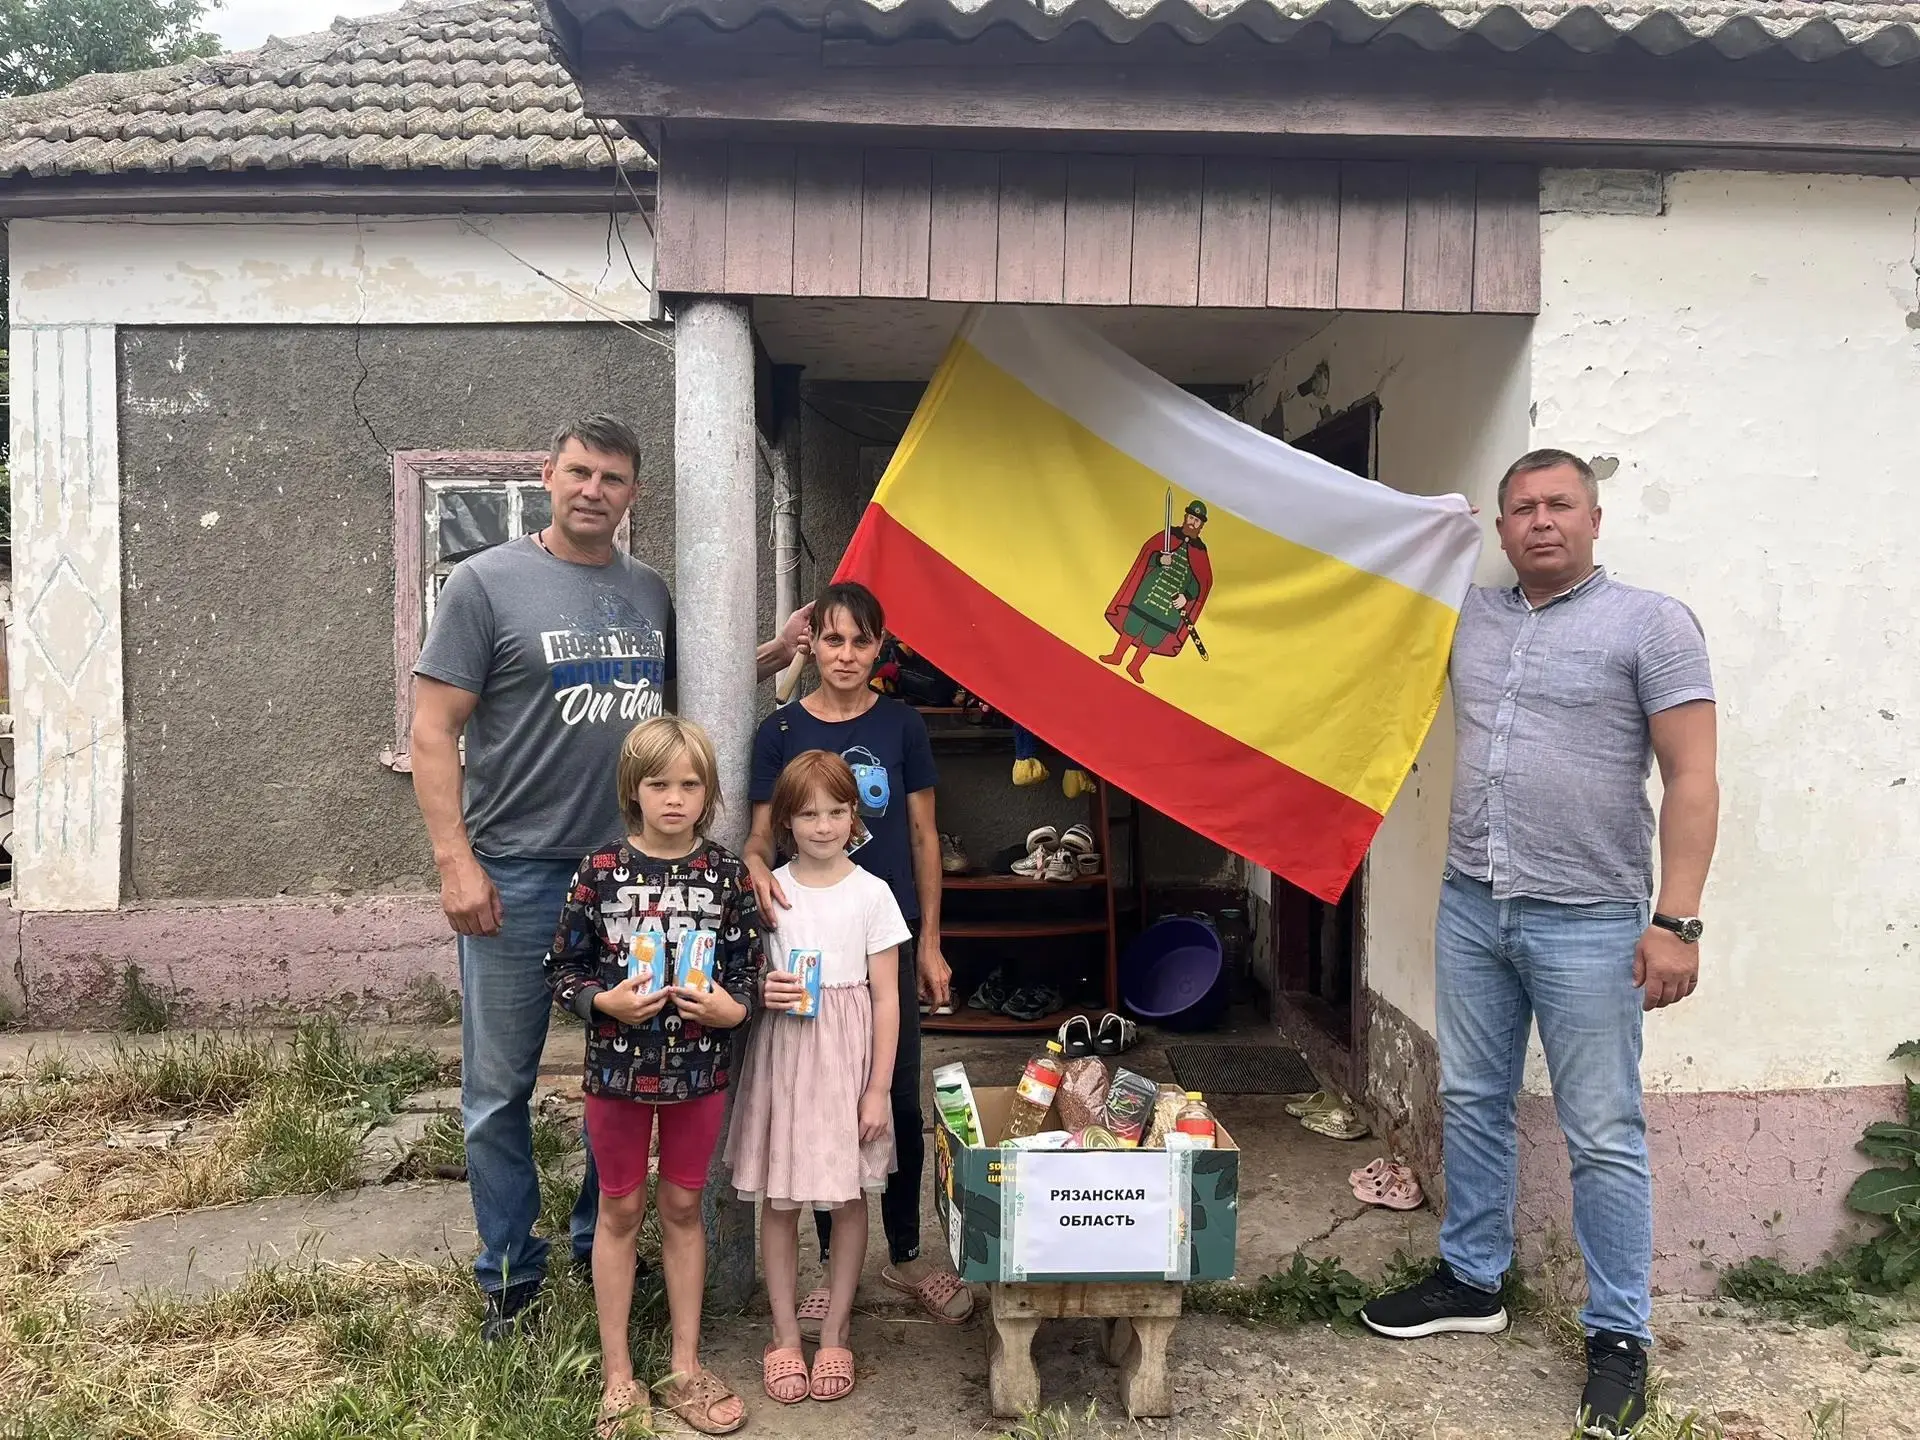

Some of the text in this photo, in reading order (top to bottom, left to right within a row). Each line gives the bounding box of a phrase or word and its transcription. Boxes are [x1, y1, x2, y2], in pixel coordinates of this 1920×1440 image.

[552, 661, 624, 689] MOVE
[555, 683, 617, 726] On
[601, 885, 721, 914] STAR
[1050, 1188, 1145, 1201] РЯЗАНСКАЯ
[1059, 1214, 1136, 1227] ОБЛАСТЬ
